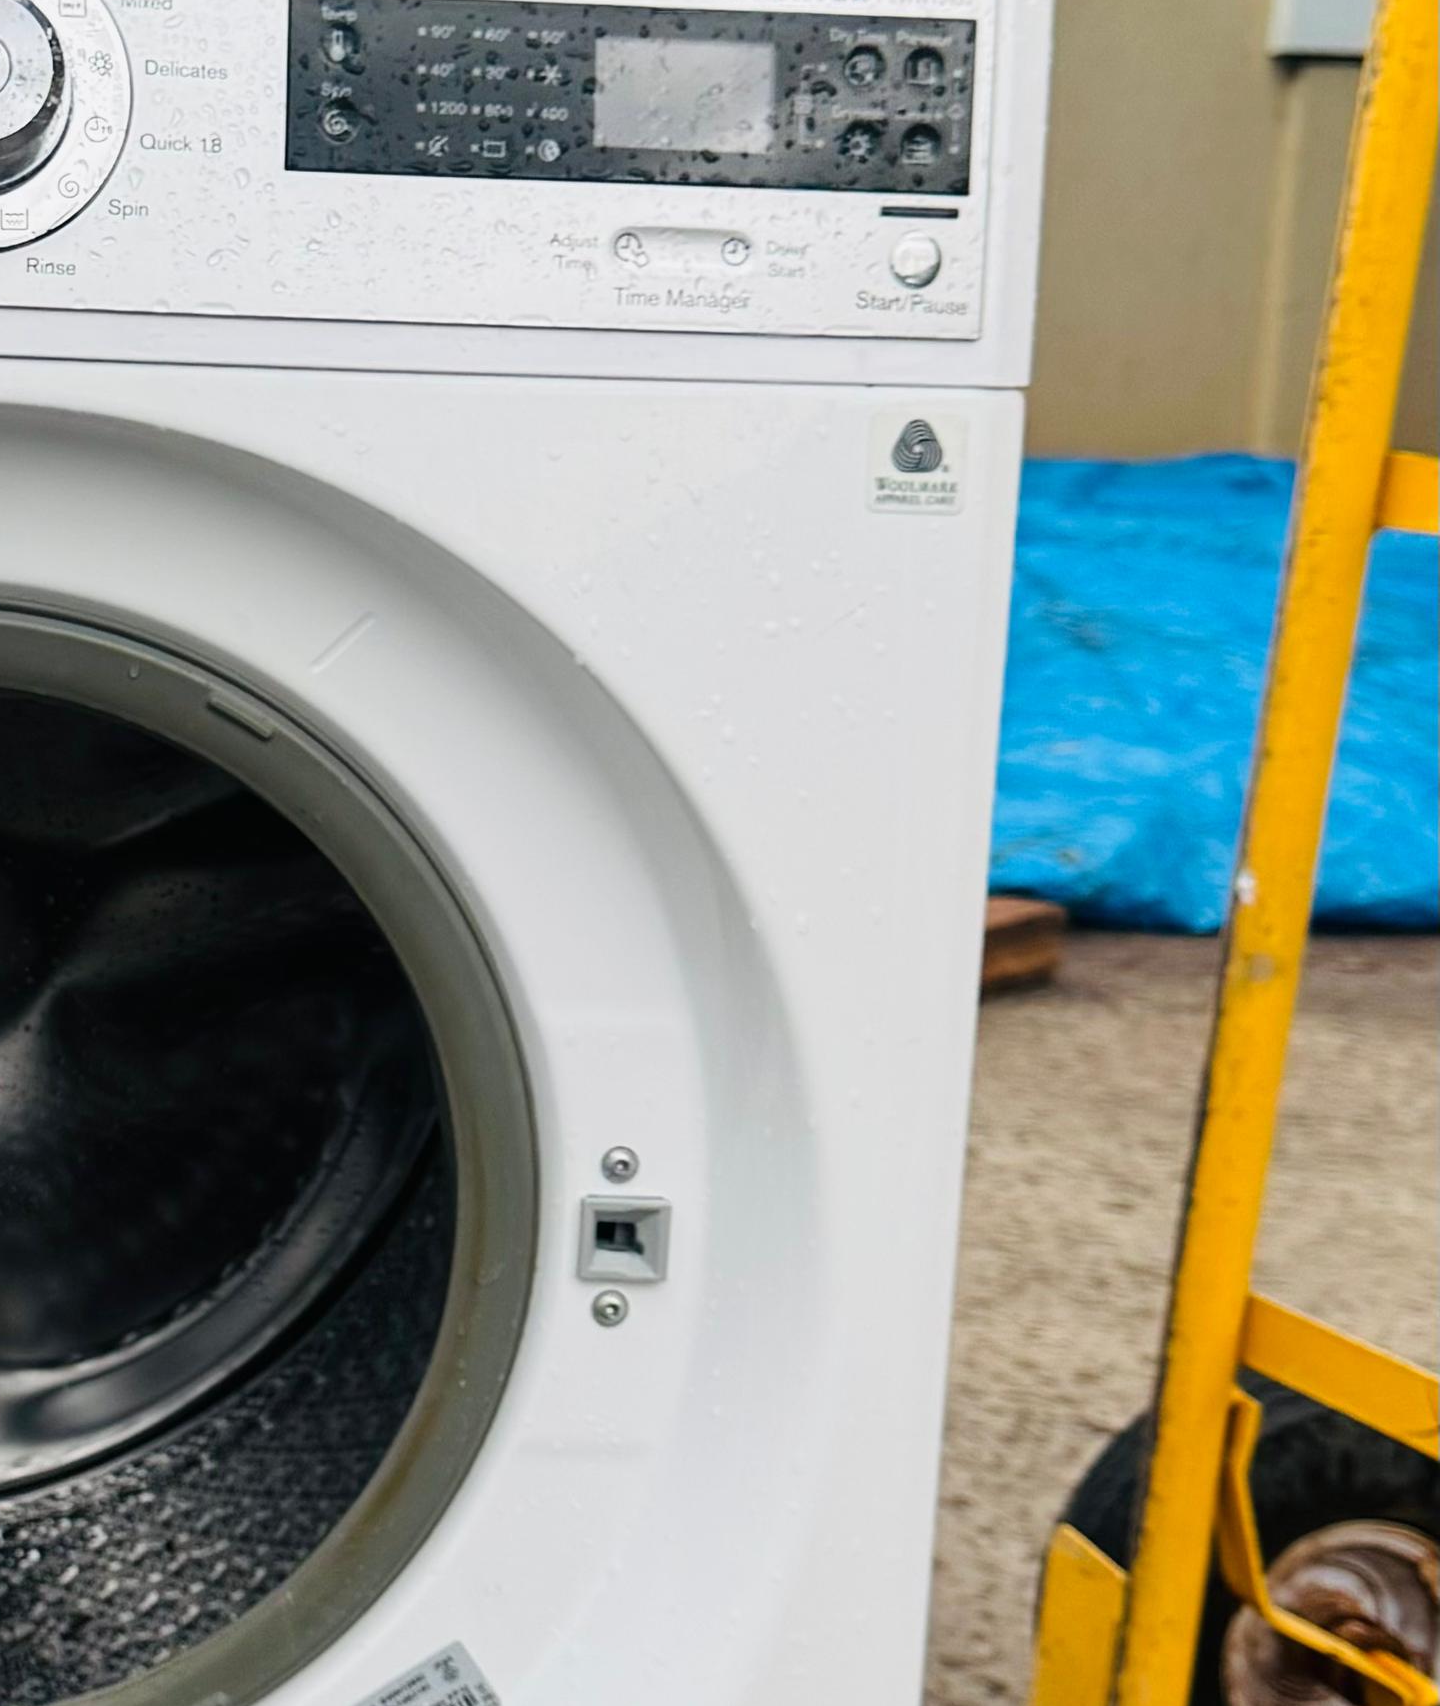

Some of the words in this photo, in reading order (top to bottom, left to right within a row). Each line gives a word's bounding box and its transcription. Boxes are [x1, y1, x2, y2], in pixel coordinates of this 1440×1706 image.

[144, 59, 229, 81] Delicates
[430, 101, 468, 116] 1200
[139, 132, 193, 154] Quick
[108, 199, 150, 221] Spin
[549, 233, 599, 252] Adjust
[25, 256, 78, 278] Rinse
[613, 288, 660, 306] Time
[666, 290, 751, 311] Manager
[856, 292, 969, 316] Start/Pause
